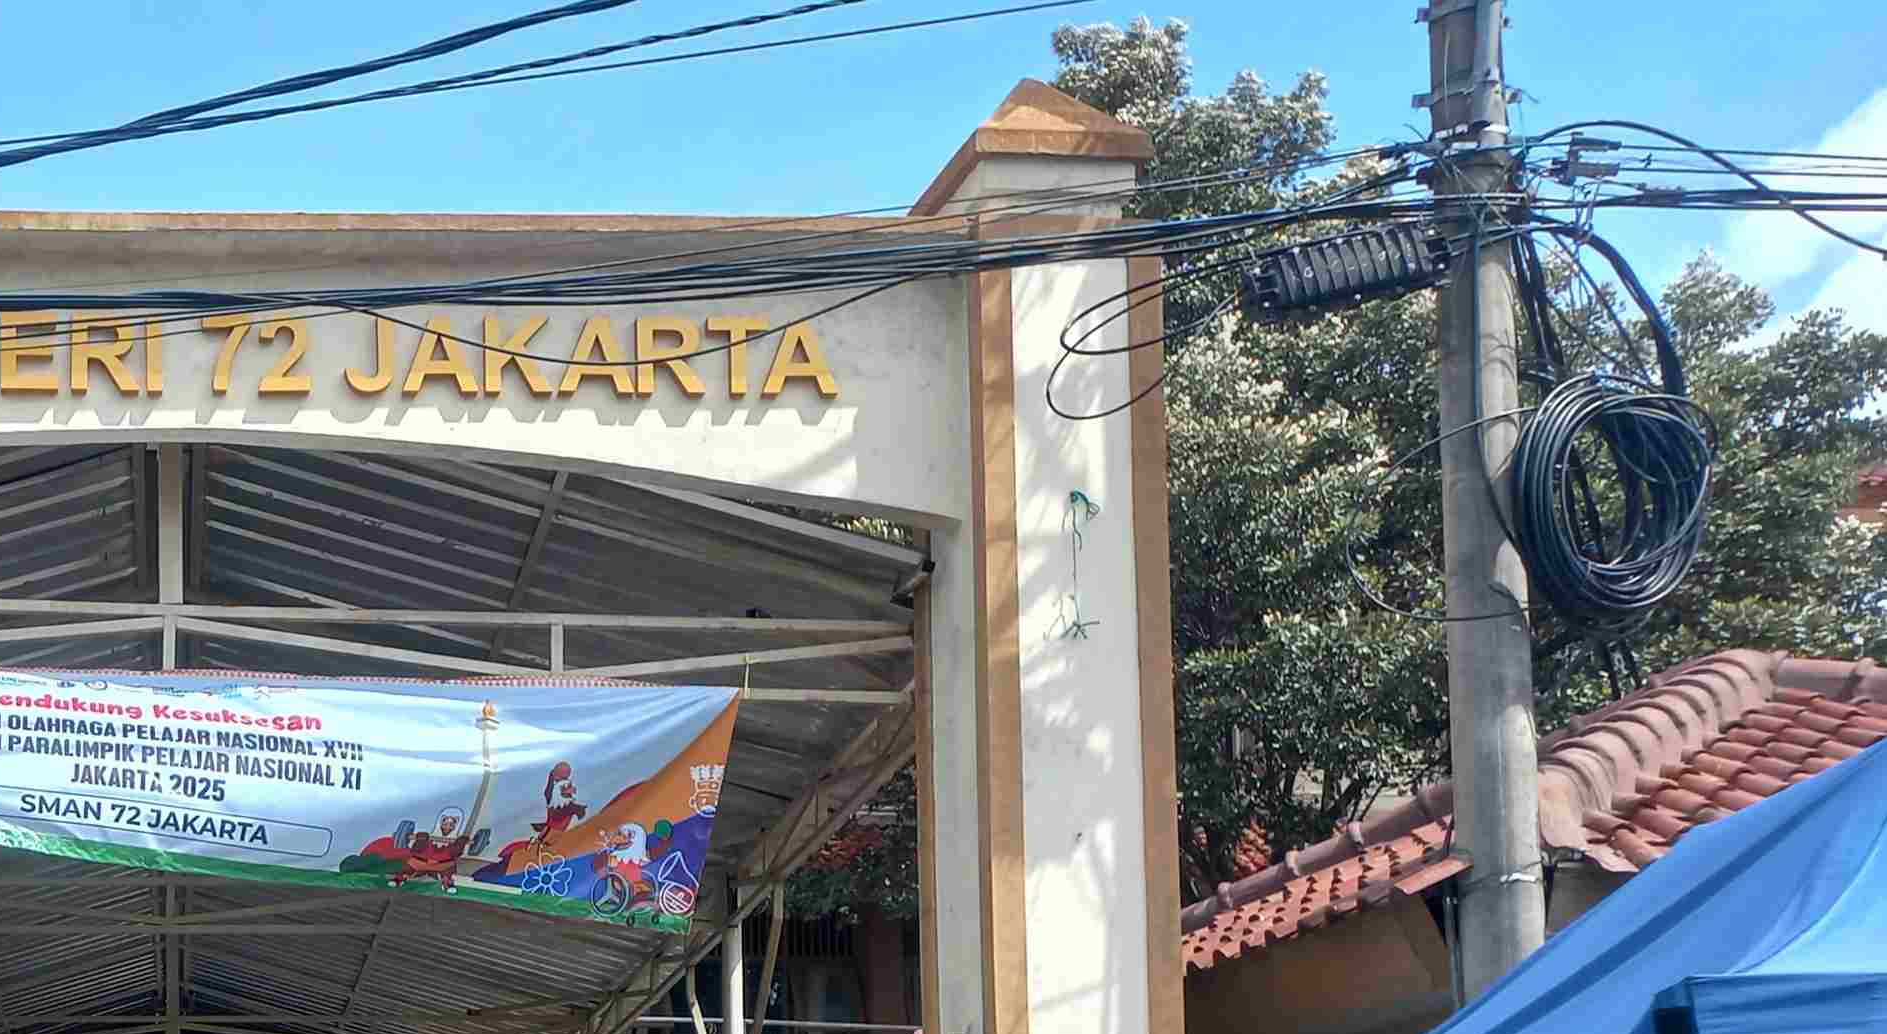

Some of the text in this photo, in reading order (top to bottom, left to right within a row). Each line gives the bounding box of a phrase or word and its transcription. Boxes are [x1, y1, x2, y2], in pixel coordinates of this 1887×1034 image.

[202, 314, 311, 396] 72
[342, 314, 838, 399] JAKARTA
[7, 714, 117, 738] OLAHRAGA
[121, 722, 211, 746] PELAJAR
[216, 730, 318, 757] NASIONAL
[153, 704, 322, 732] Kesuksesan
[7, 734, 135, 762] PARALIMPIK
[140, 743, 230, 774] PELAJAR
[235, 754, 336, 787] NASIONAL
[340, 765, 363, 791] XI
[70, 763, 227, 802] JAKARTA 2025
[20, 793, 269, 846] SMAN 72 JAKARTA
